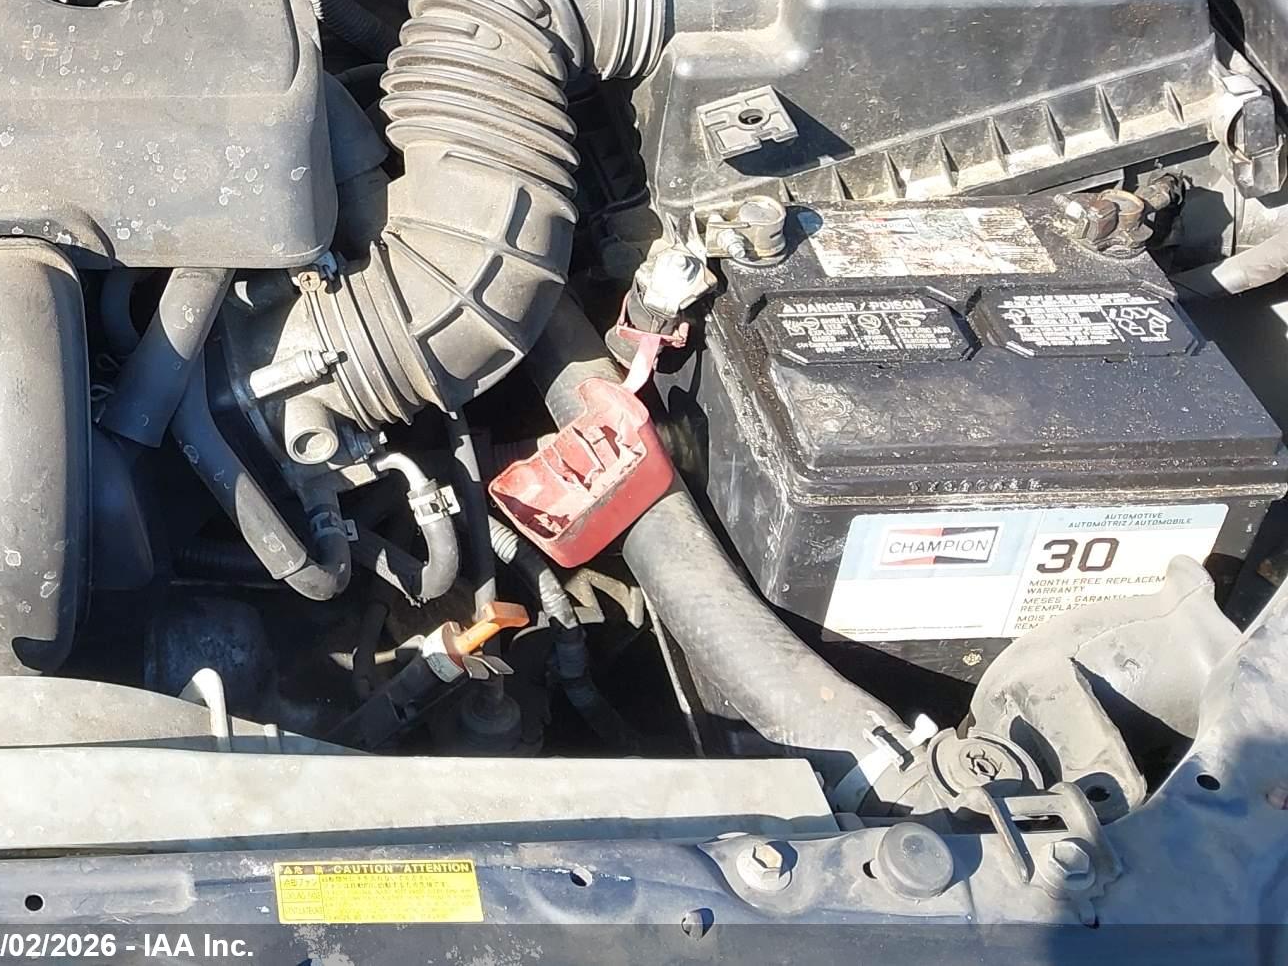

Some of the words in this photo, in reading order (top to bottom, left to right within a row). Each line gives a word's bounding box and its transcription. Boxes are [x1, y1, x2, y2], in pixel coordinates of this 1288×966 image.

[796, 301, 857, 313] DANGER
[870, 299, 925, 311] POISON
[1104, 512, 1164, 520] AUTOMOTIVE
[889, 539, 989, 554] CHAMPION
[1036, 537, 1120, 574] 30
[1029, 579, 1070, 587] MONTH
[1073, 577, 1102, 585] FREE
[1027, 586, 1085, 594] WARRANTY
[333, 864, 394, 874] CAUTION
[404, 862, 470, 873] ATTENTION
